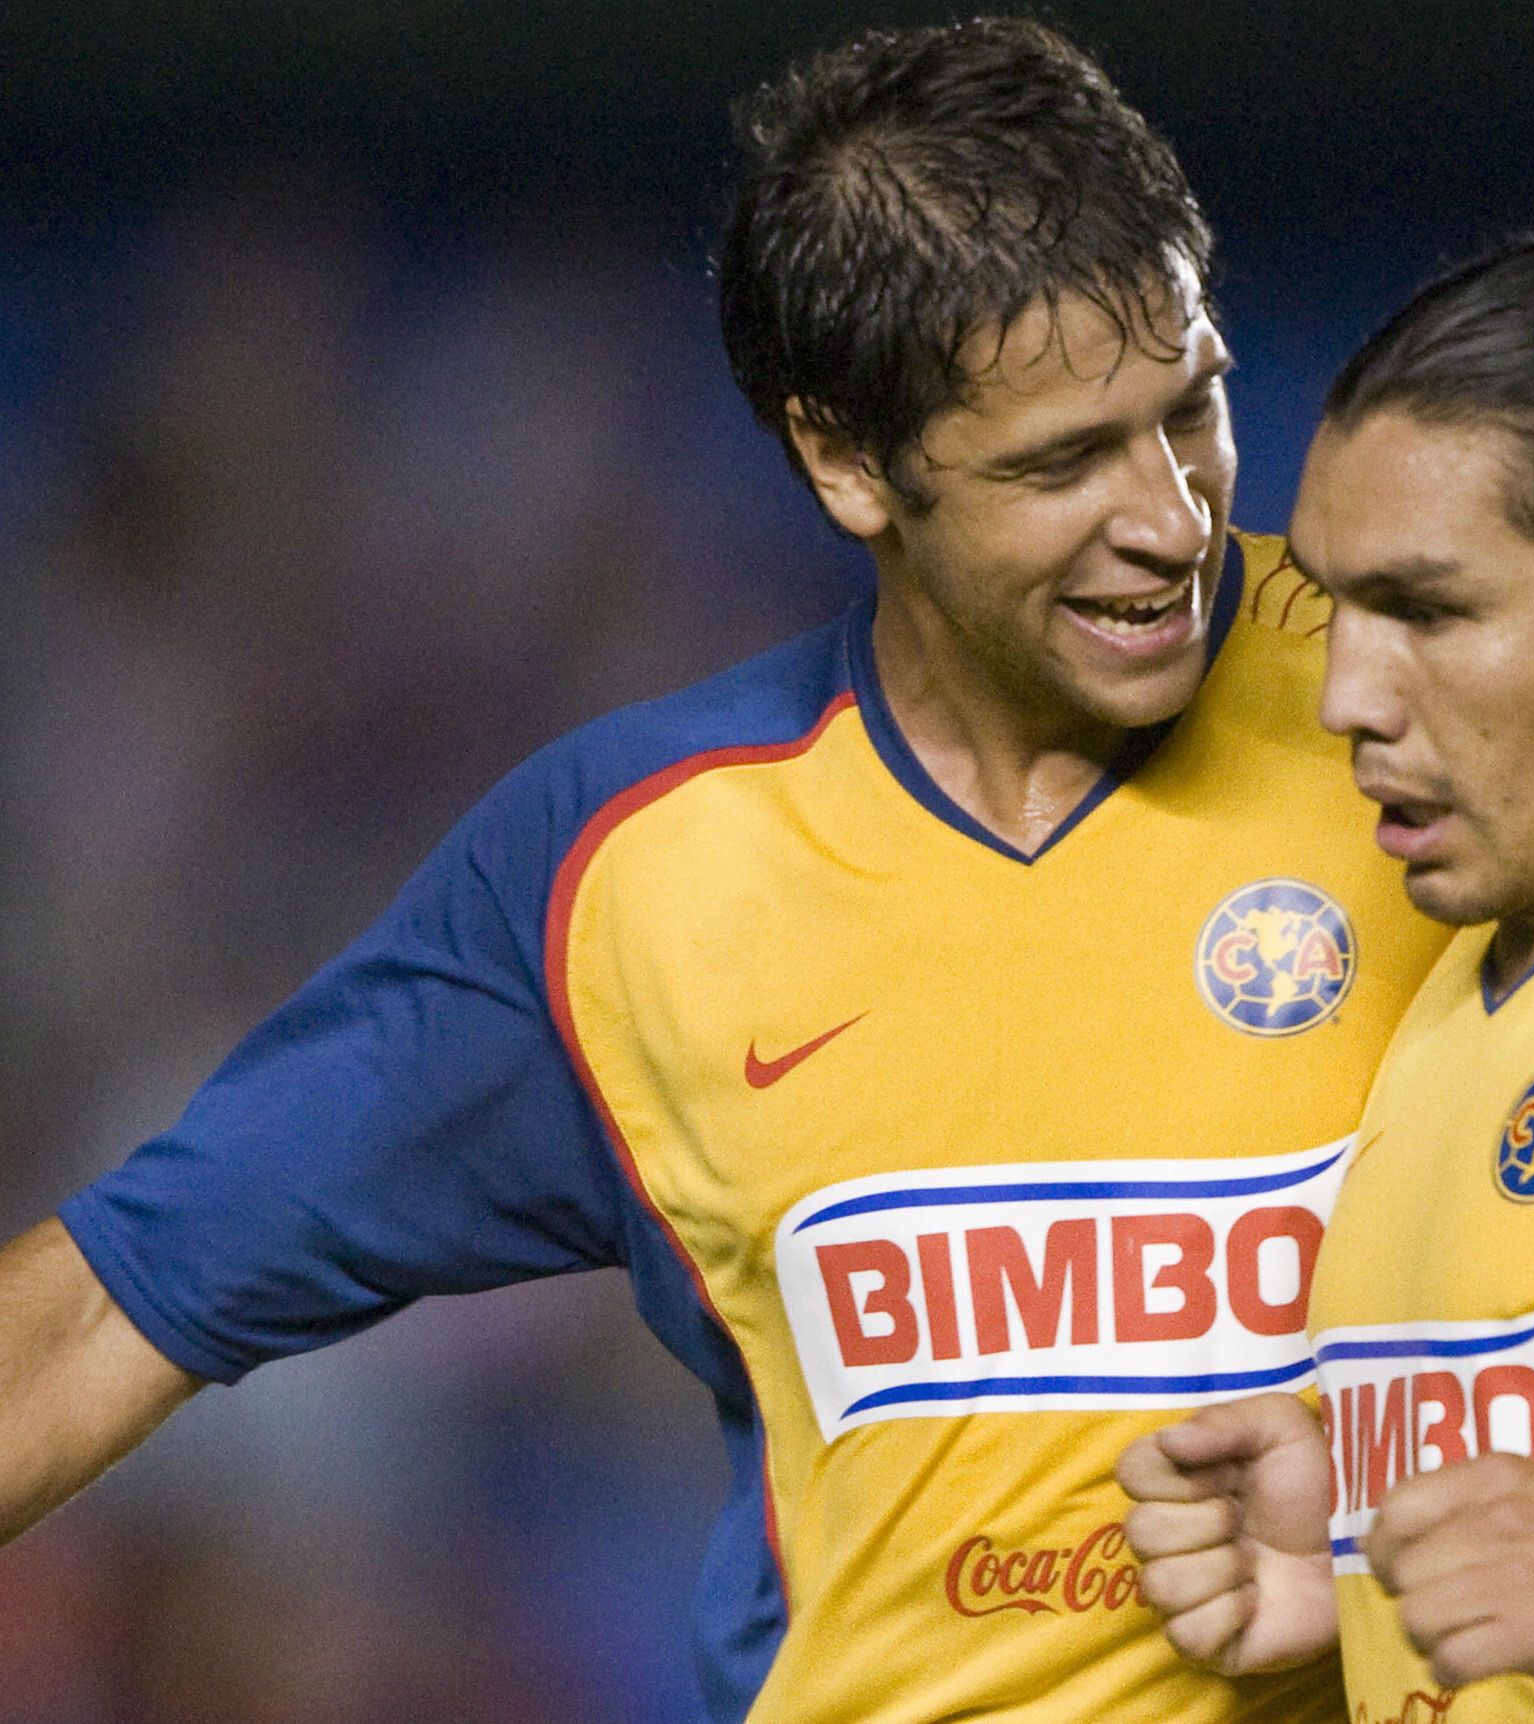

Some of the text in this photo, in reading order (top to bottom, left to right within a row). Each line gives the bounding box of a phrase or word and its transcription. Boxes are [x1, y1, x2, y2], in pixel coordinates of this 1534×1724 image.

[1213, 927, 1342, 984] C A
[815, 1205, 1326, 1368] BIMBO
[945, 1522, 1148, 1618] Coca-Co
